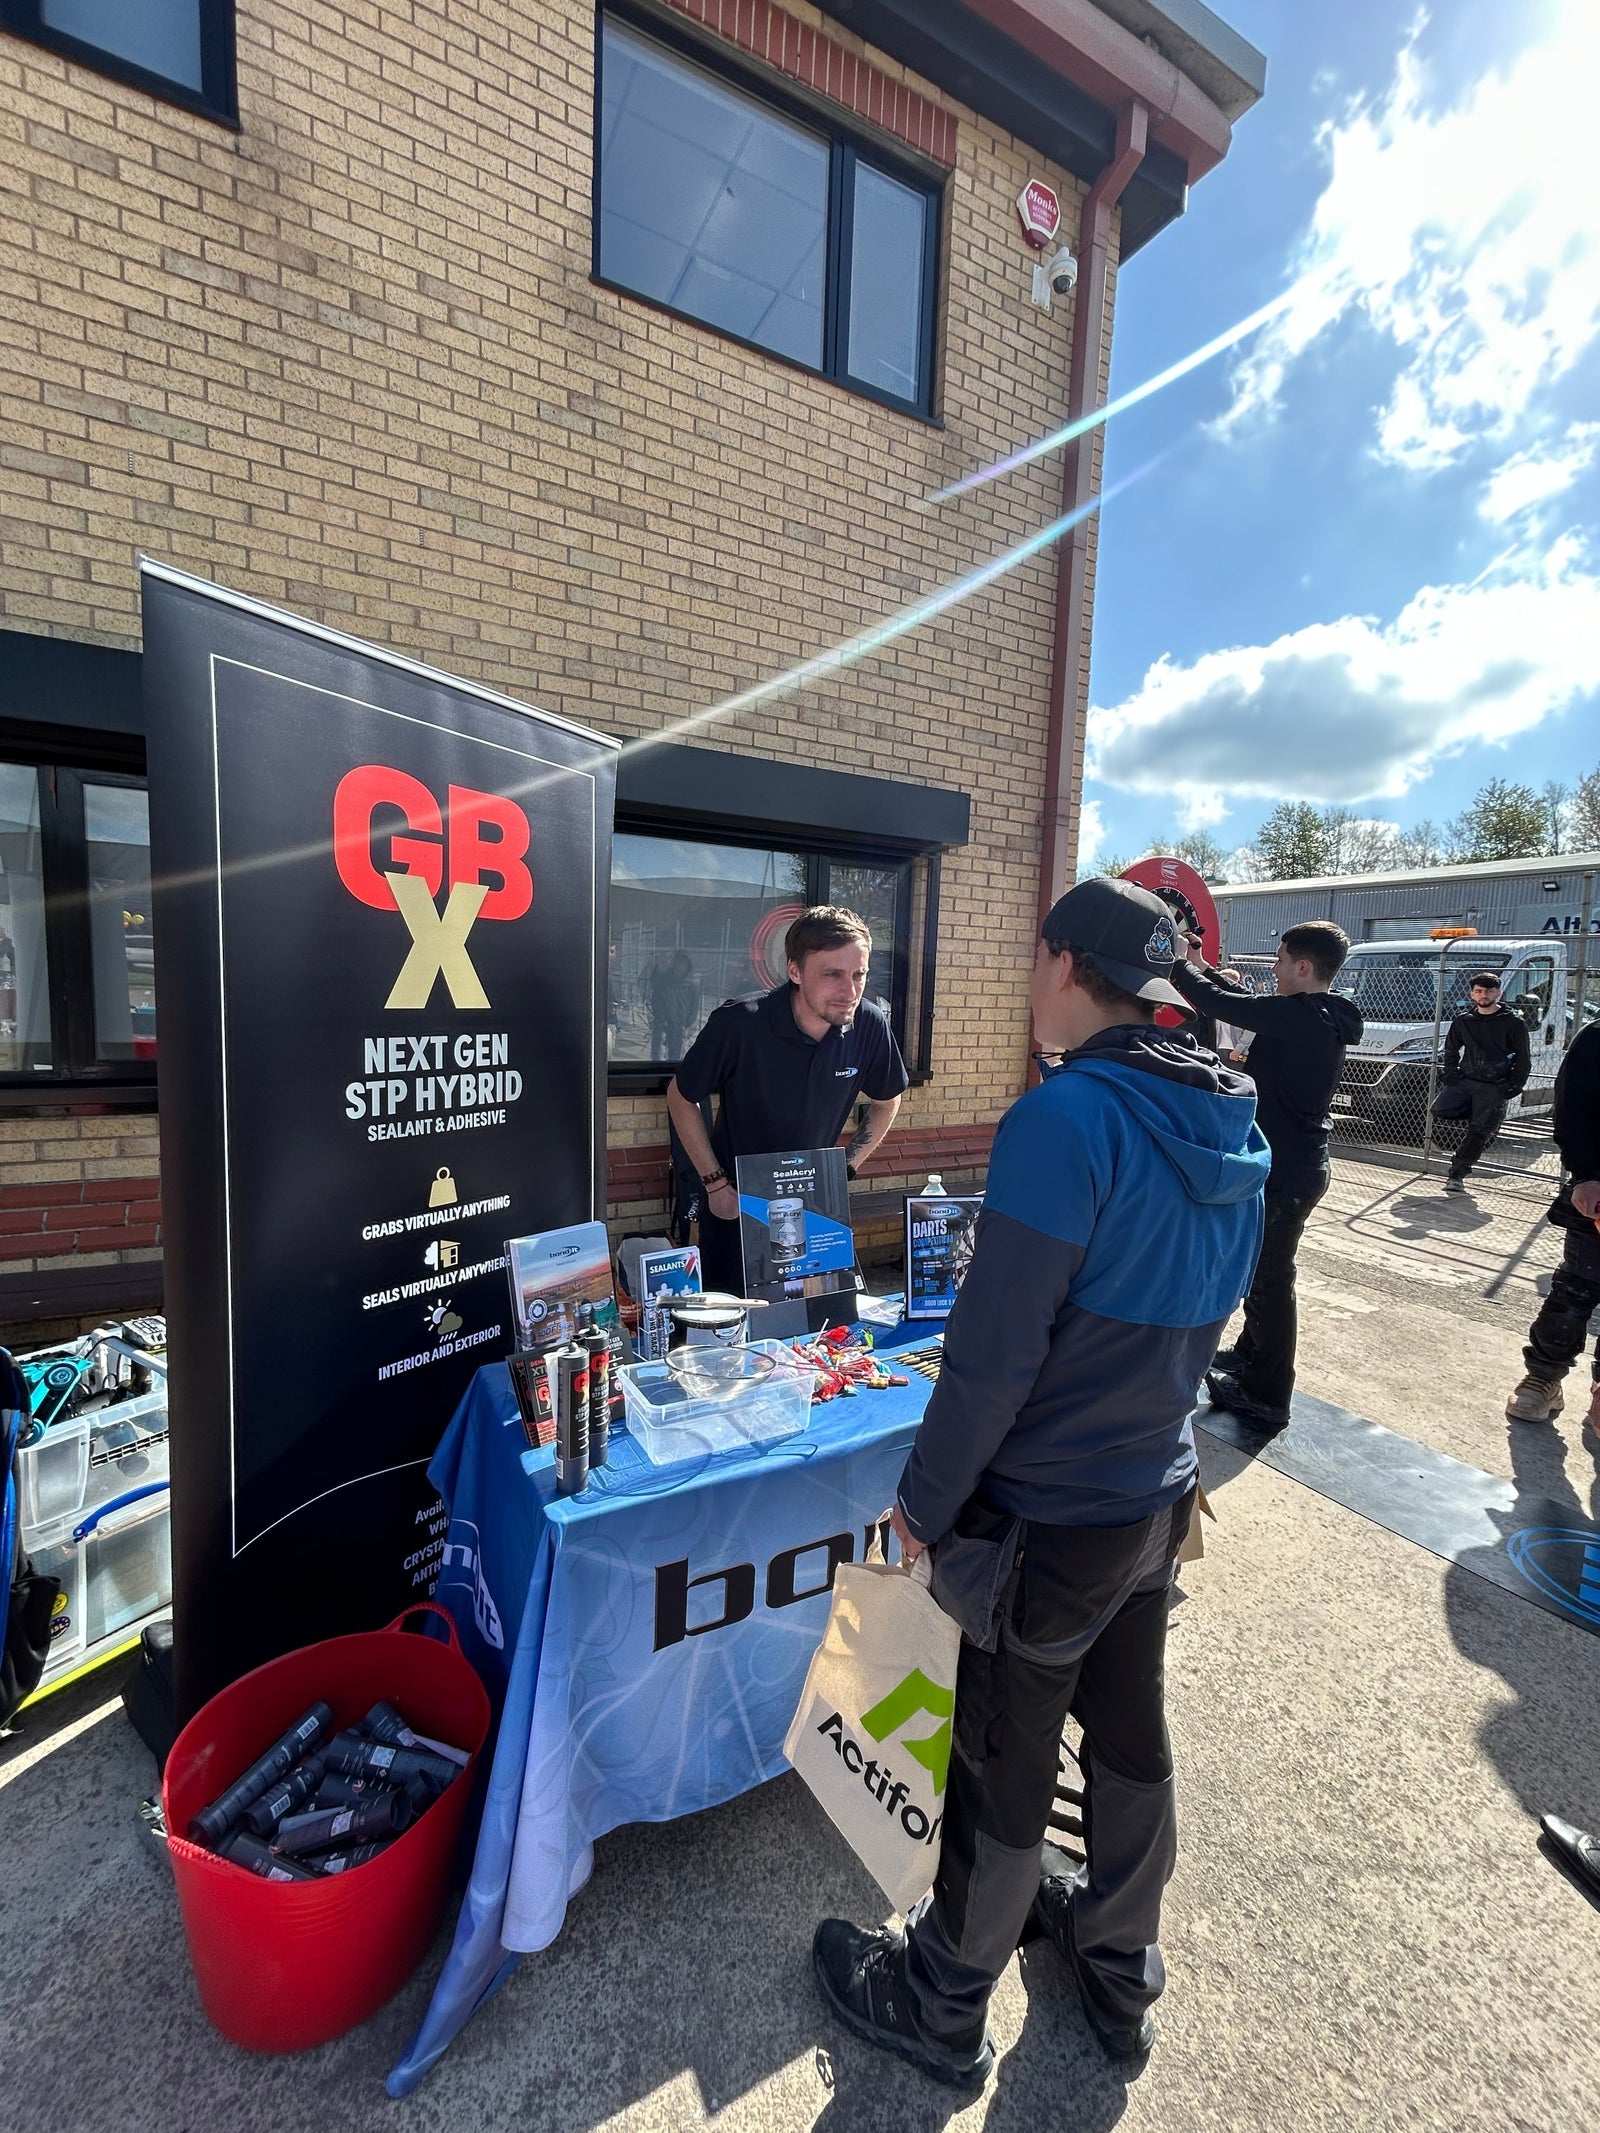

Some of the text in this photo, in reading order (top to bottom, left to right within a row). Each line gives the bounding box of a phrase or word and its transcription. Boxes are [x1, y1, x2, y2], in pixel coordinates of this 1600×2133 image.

[1028, 189, 1057, 215] Monks
[333, 765, 534, 920] GB
[384, 871, 491, 1009] X
[364, 1033, 509, 1074] NEXT GEN
[345, 1070, 523, 1120] STP HYBRID
[367, 1109, 506, 1142] SEALANT & ADHESIVE
[773, 1167, 816, 1178] SealAcryl
[362, 1195, 511, 1240] GRABS VIRTUALLY ANYTHING
[913, 1219, 948, 1239] DARTS
[549, 1249, 570, 1258] bond
[649, 1260, 686, 1274] SEALANTS
[362, 1254, 511, 1310] SEALS VIRTUALLY ANYWHERE
[378, 1324, 501, 1381] INTERIOR AND EXTERIOR
[428, 1580, 439, 1596] B
